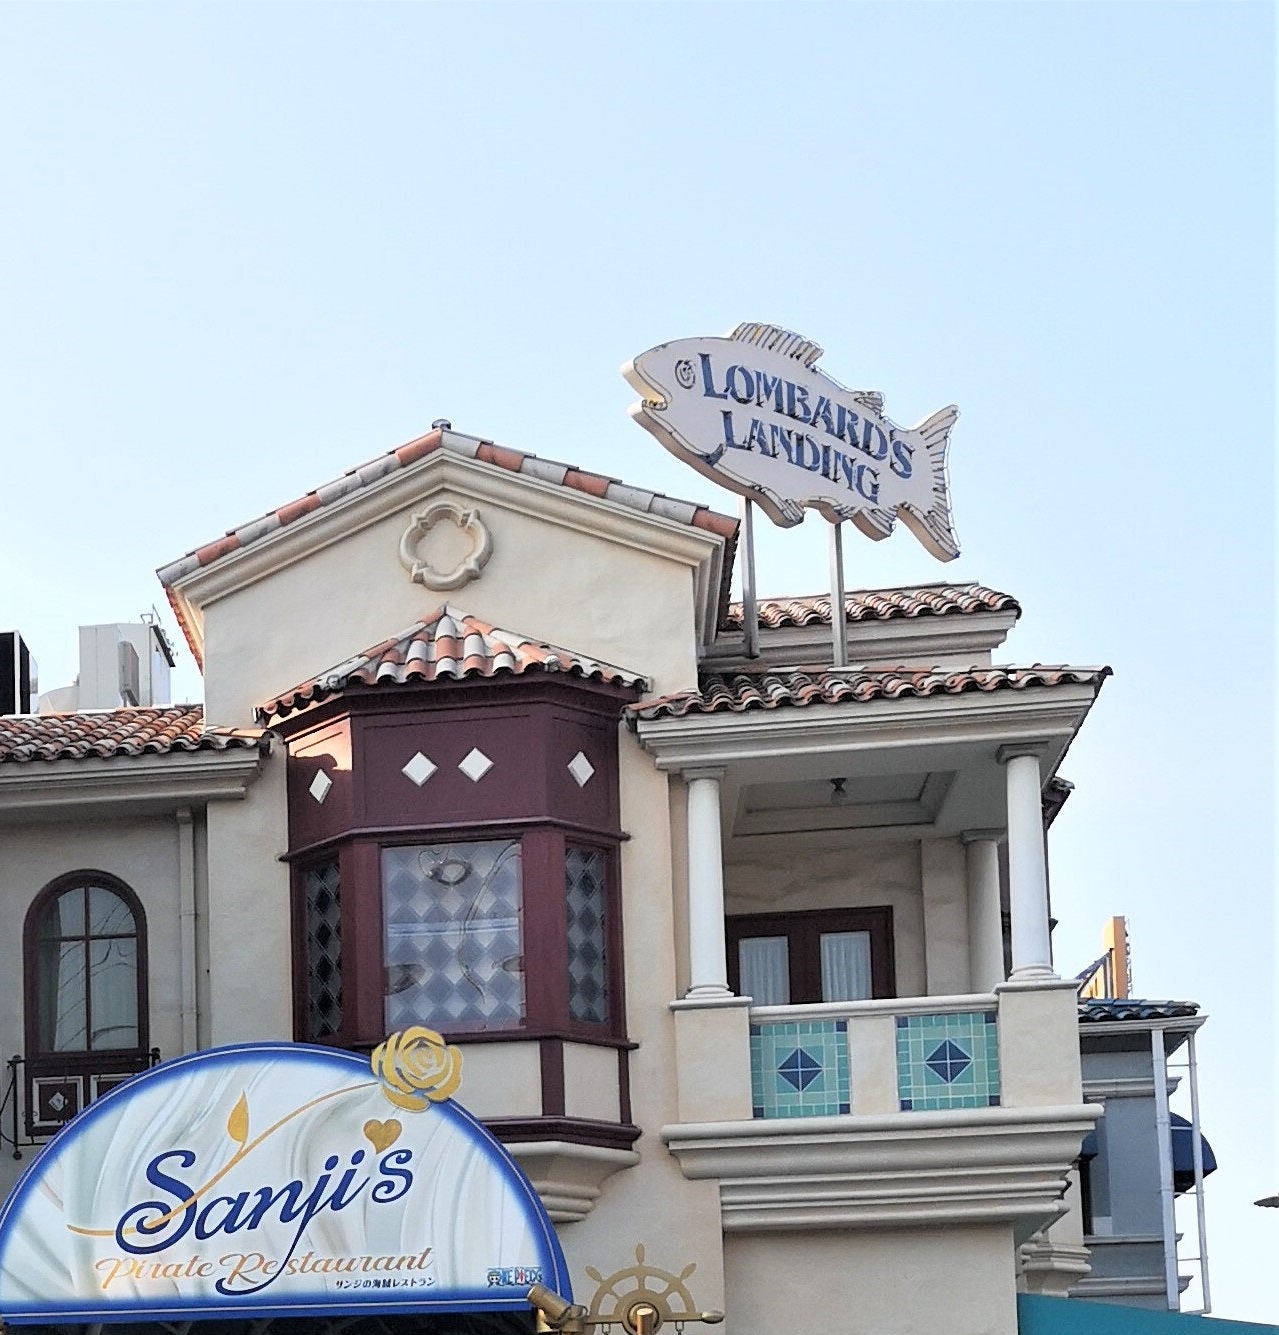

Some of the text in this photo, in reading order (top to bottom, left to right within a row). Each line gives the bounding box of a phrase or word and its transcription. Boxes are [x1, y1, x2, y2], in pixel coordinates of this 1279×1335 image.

[697, 352, 915, 479] LOMBARD'S
[720, 410, 881, 504] LANDING
[95, 1247, 435, 1291] Pirate Restaurant
